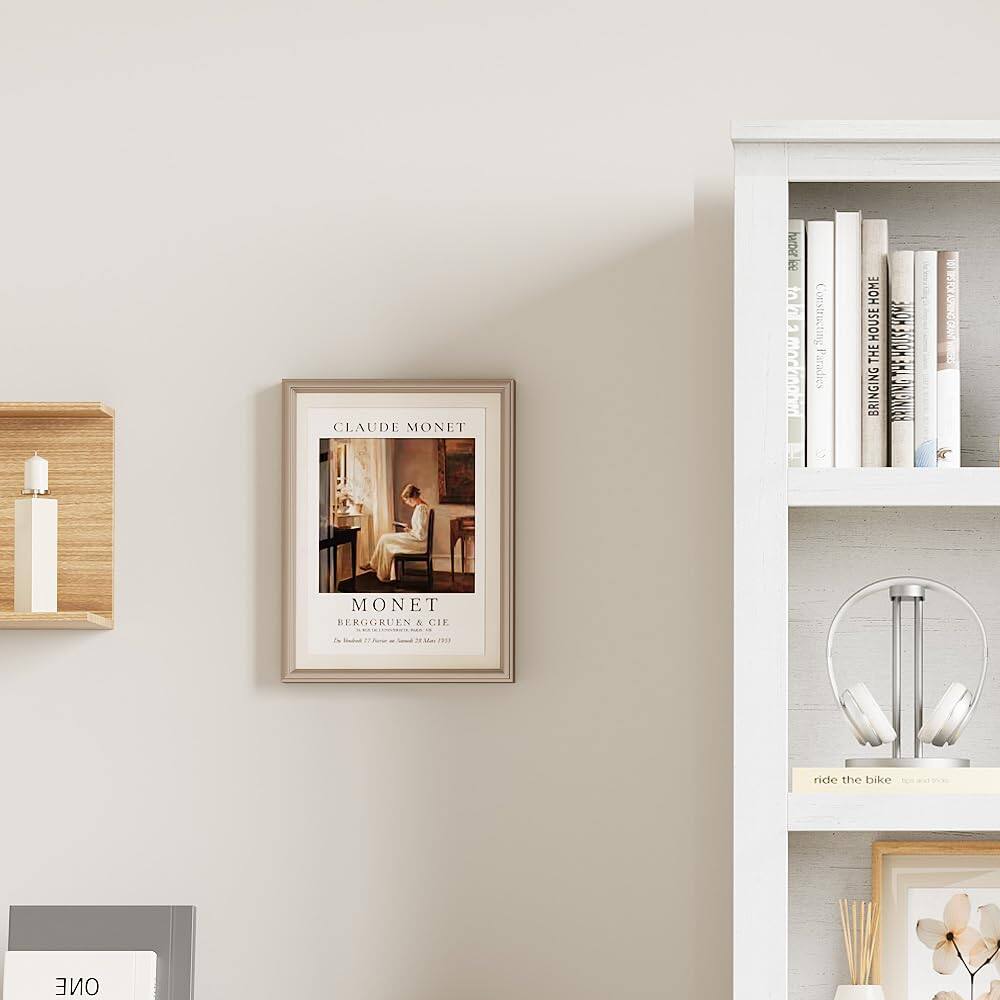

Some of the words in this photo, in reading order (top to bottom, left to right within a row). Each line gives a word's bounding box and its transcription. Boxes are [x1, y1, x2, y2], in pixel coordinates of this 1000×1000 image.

[788, 259, 801, 272] lee
[868, 276, 880, 306] HOME
[814, 283, 827, 346] Constructing
[891, 301, 914, 326] HOME
[868, 308, 880, 342] HOUSE
[946, 320, 956, 340] GRANT
[891, 329, 914, 357] HOUSE
[868, 344, 880, 365] THE
[891, 360, 914, 377] THE
[867, 367, 880, 416] BRINGING
[891, 379, 914, 422] BRINGING
[332, 422, 400, 433] CLAUDE
[406, 422, 466, 433] MONET
[352, 597, 440, 612] MONET
[337, 618, 411, 627] BERGGRUEN
[416, 618, 423, 627] &
[429, 618, 450, 627] CIE
[813, 775, 838, 785] ride
[841, 775, 862, 785] the
[865, 775, 892, 785] bike
